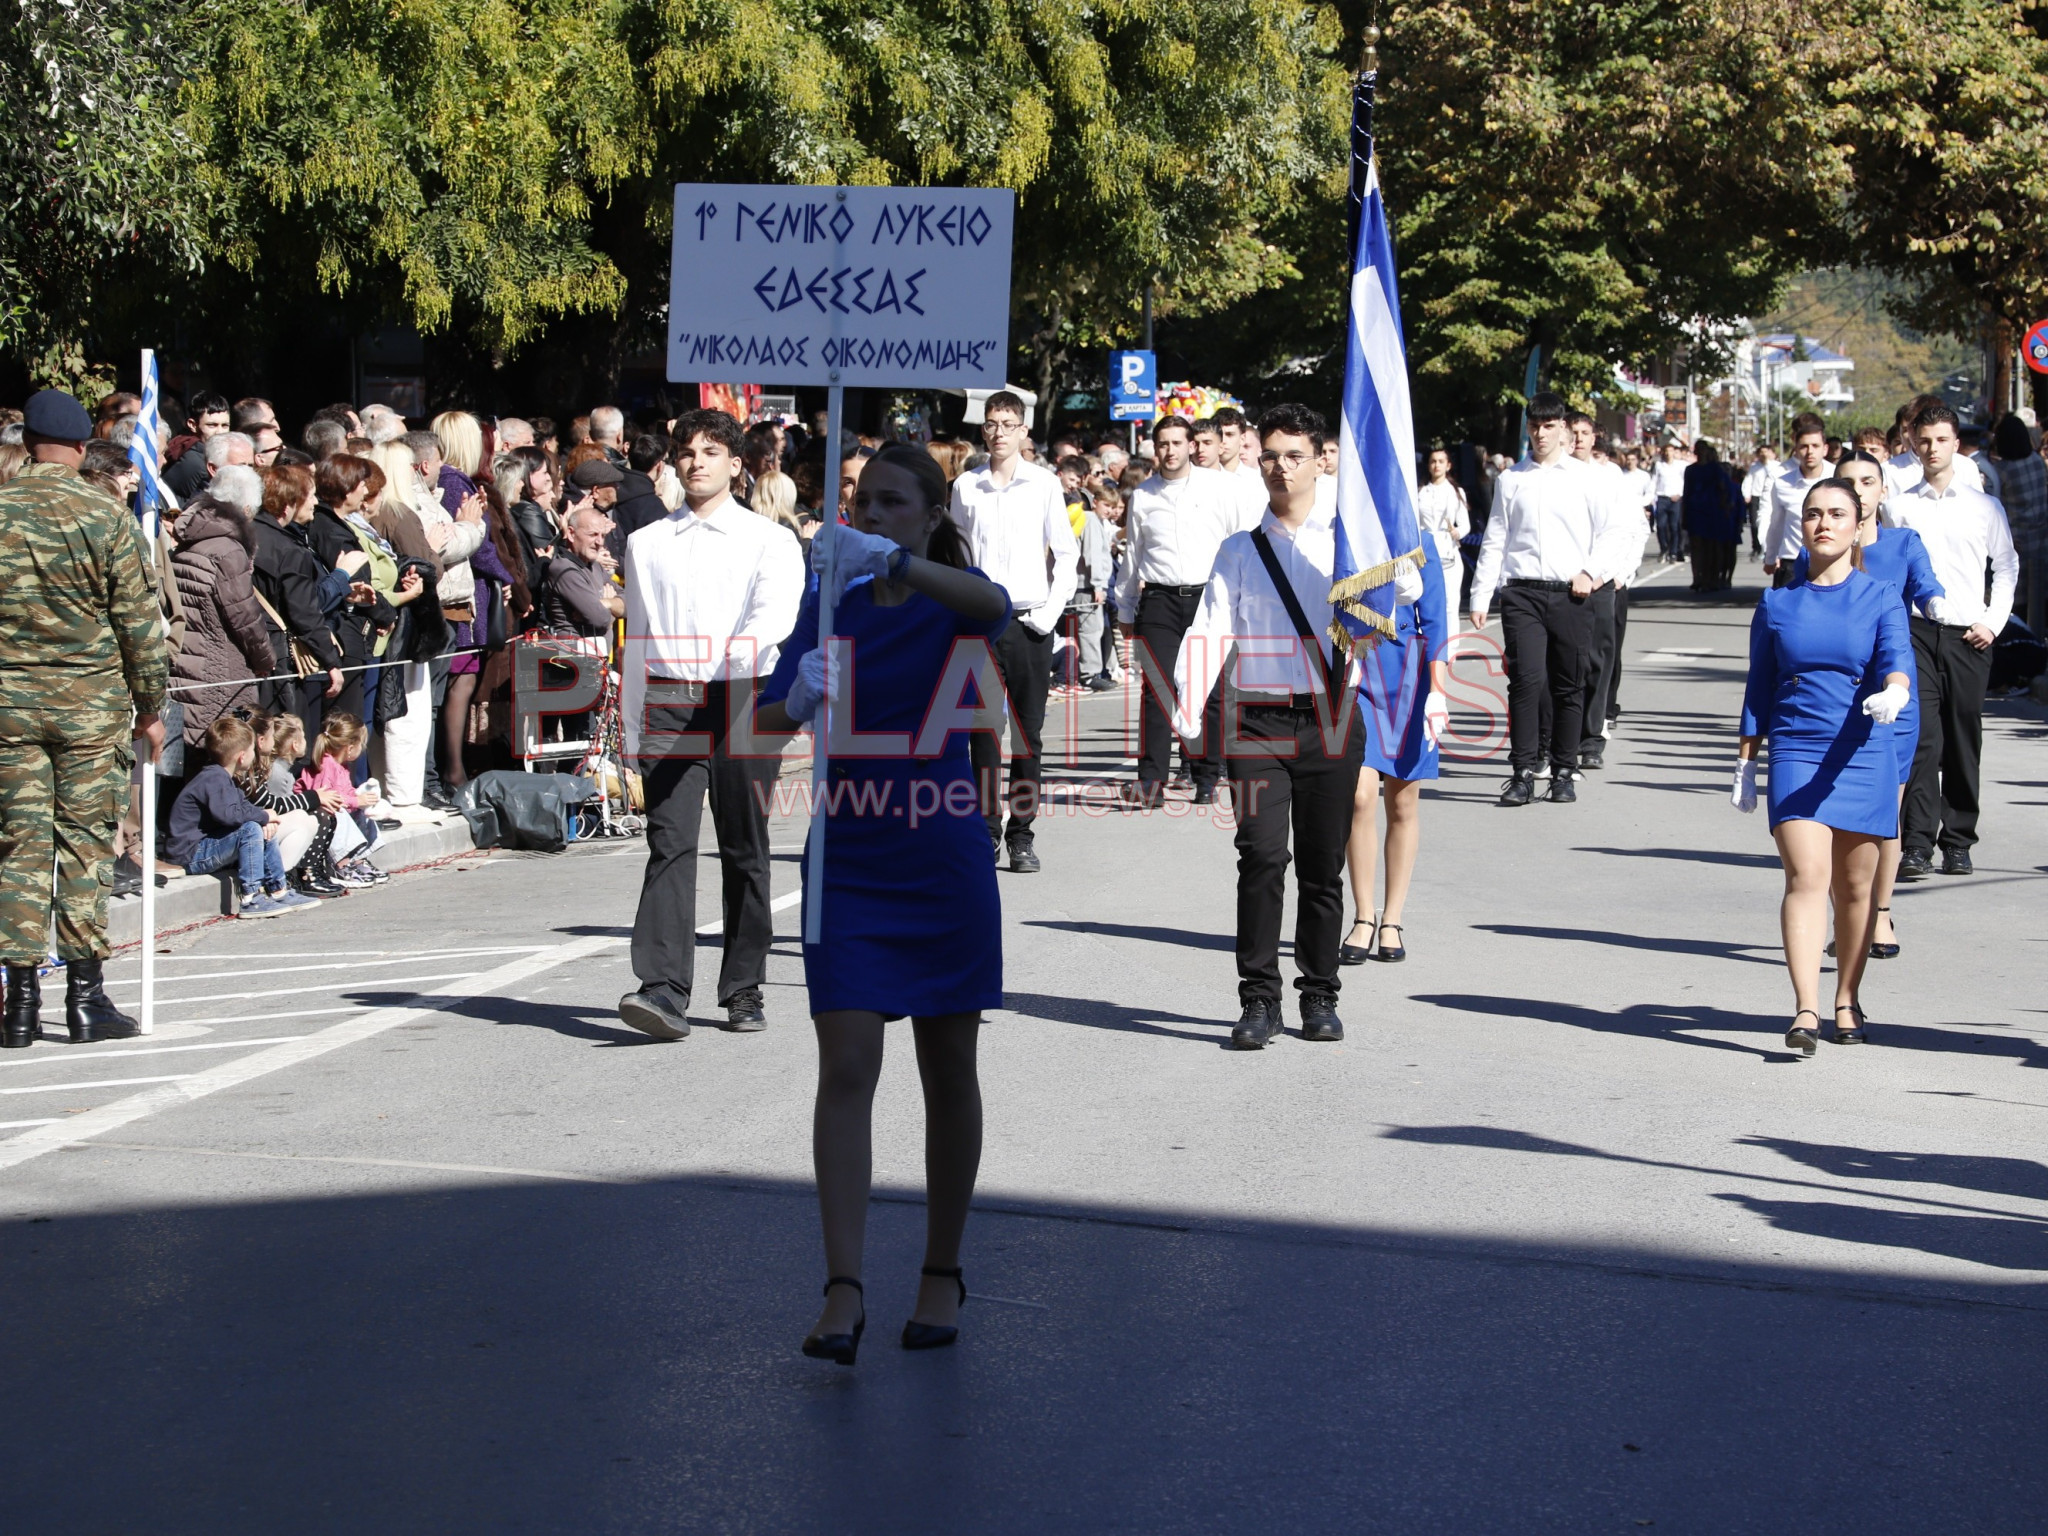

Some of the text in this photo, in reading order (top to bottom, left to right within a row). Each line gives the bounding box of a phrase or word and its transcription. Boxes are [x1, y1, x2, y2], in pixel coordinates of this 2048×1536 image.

[736, 202, 854, 244] ΓΕΝΙΚΟ
[871, 203, 992, 247] ΛΥΚΕΙΟ
[753, 266, 927, 316] ΕΔΕΣΣΑΣ
[1121, 356, 1145, 387] P
